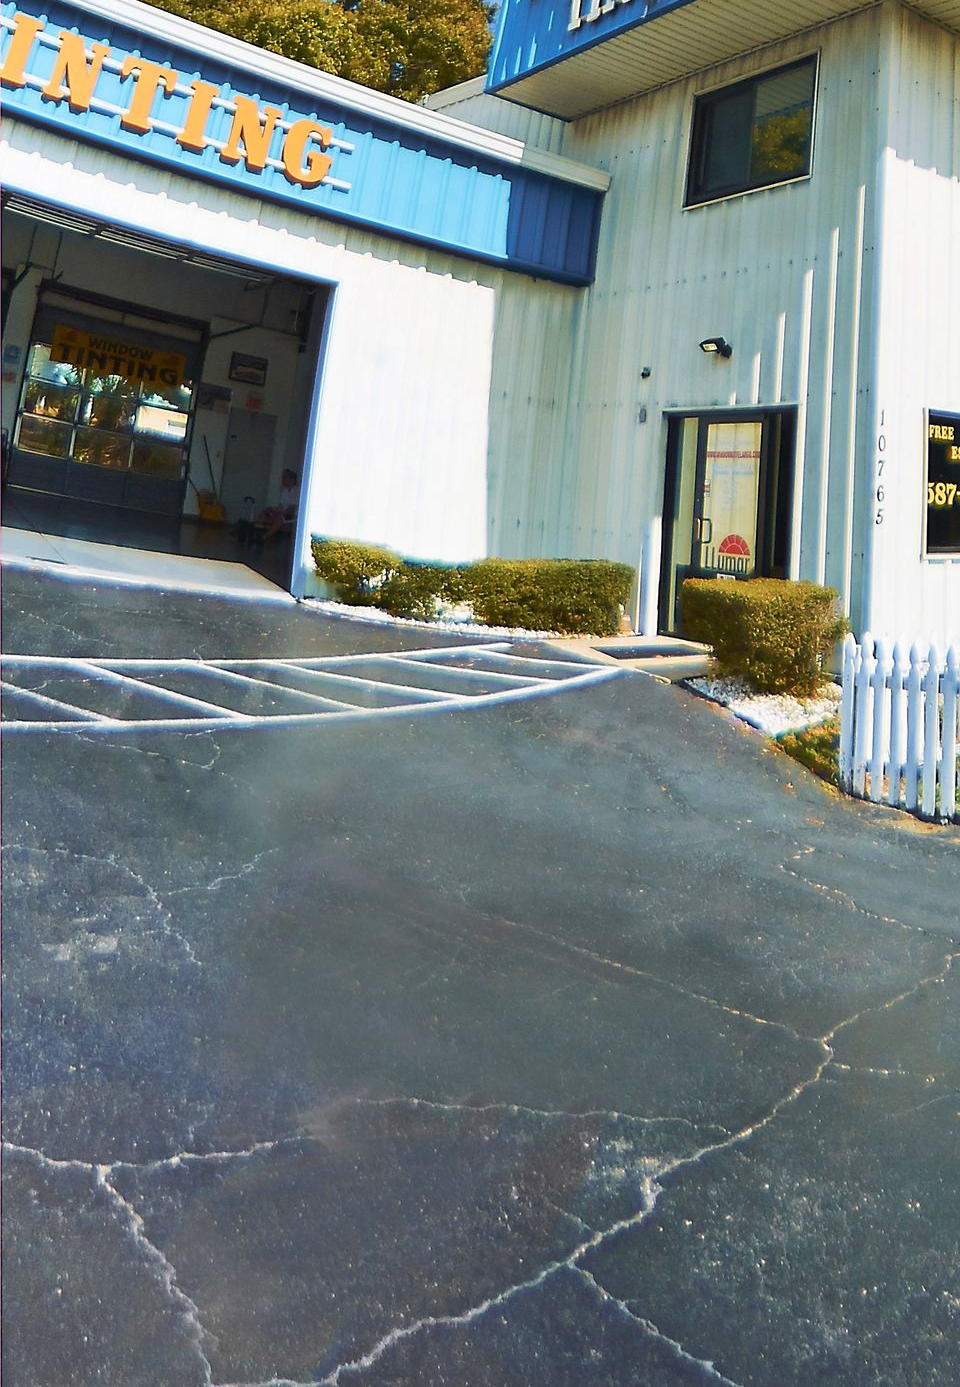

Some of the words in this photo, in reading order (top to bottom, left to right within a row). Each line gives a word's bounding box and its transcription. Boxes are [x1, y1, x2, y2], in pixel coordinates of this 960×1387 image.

[88, 335, 154, 362] WINDOW
[58, 343, 178, 386] TINTING
[929, 424, 955, 441] FREE
